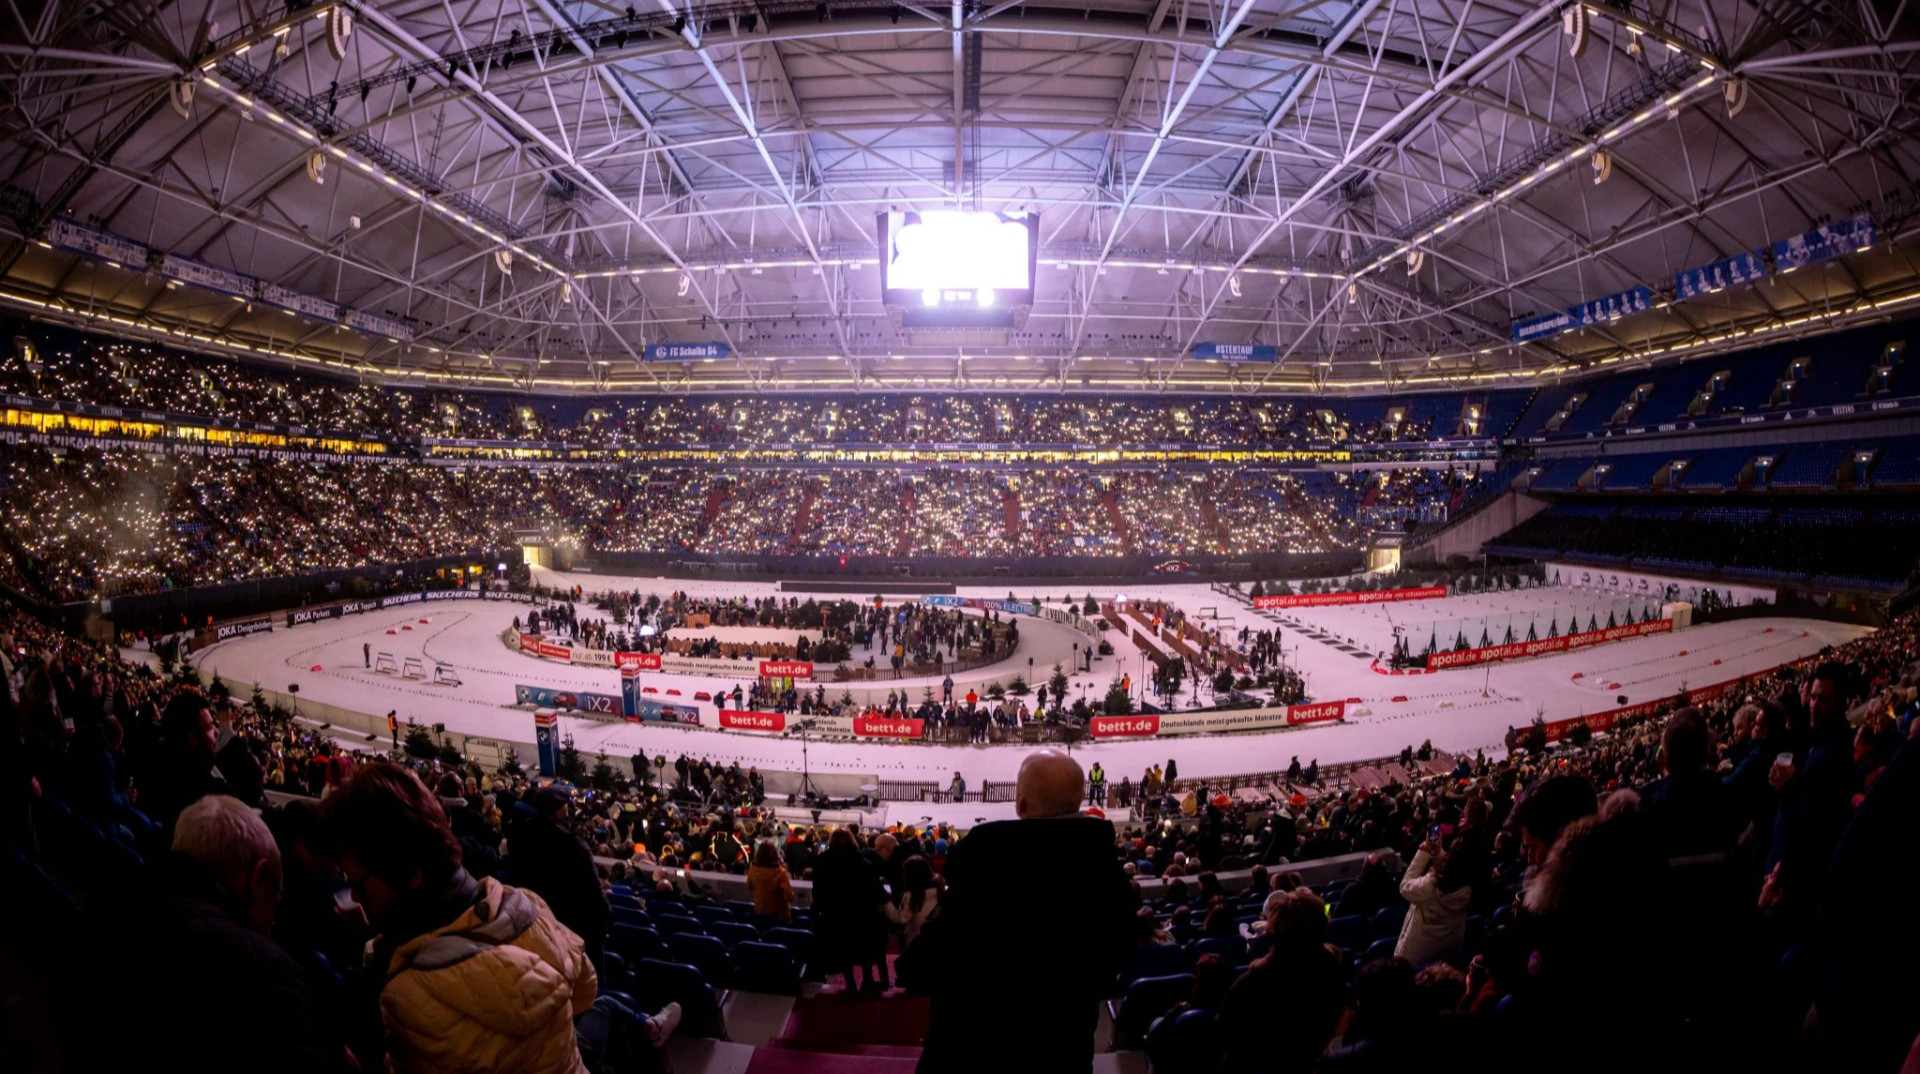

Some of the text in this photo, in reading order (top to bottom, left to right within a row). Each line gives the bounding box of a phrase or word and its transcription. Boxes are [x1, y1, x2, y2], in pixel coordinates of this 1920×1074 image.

[670, 346, 717, 357] FC Schalke 04
[101, 406, 122, 417] VELTINS
[1832, 404, 1855, 415] VELTINS
[1658, 424, 1676, 432] VELTINS
[382, 592, 422, 606] SKECHERS
[426, 590, 479, 599] SKECHERS
[484, 591, 532, 601] SKECHERS
[1258, 598, 1297, 609] apotal.de
[1311, 595, 1357, 604] VERSANDAPOTHEKE
[1359, 592, 1393, 602] apotal.de
[1405, 589, 1445, 598] VERSANDAPOTHEKE
[343, 603, 359, 615] JOKA
[984, 600, 1035, 614] 100% ELECTRIC
[294, 610, 330, 624] JOKA Parkett
[1050, 609, 1072, 624] VELTINS
[218, 620, 272, 639] JOKA Designböden
[521, 638, 538, 650] bett1.de
[1431, 620, 1670, 667] apotal.de apotal.de apotal.de apotal.de apotal.de apotal.de
[594, 653, 606, 662] 199
[619, 655, 656, 666] bett1.de
[766, 664, 808, 674] bett1.de
[587, 697, 612, 713] iX2
[679, 712, 697, 722] iX2
[1294, 706, 1338, 720] bett1.de
[730, 716, 773, 726] bett1.de
[1161, 720, 1205, 728] Deutschlands
[866, 724, 911, 734] bett1.de
[1098, 721, 1152, 733] bett1.de
